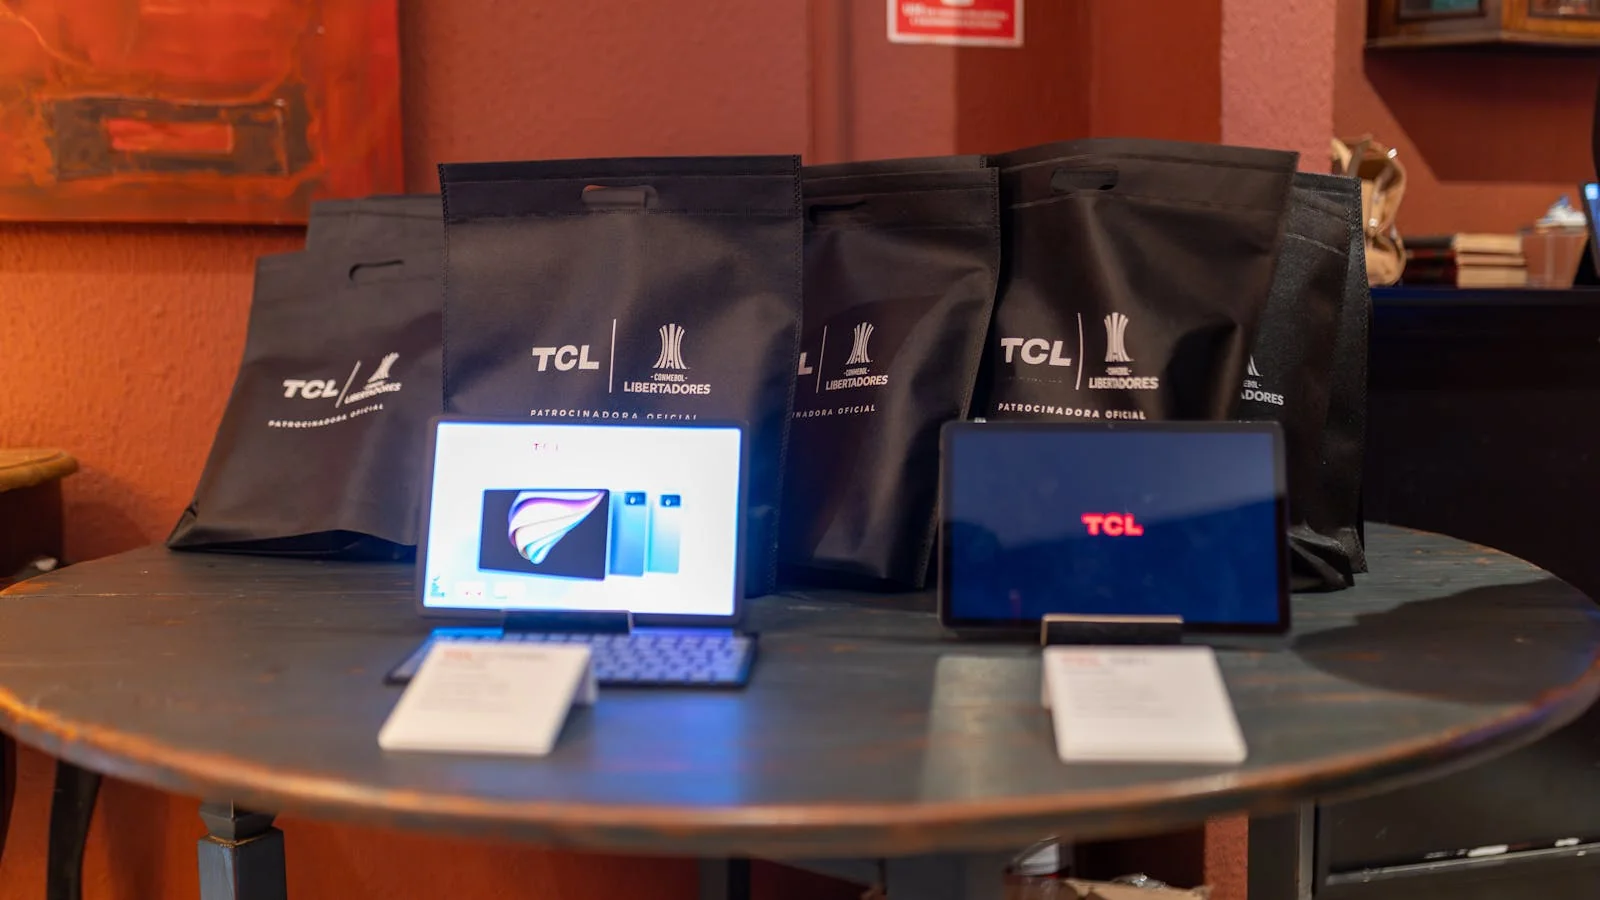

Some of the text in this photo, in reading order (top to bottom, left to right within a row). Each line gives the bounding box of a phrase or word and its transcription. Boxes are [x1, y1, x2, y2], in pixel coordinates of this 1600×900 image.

[532, 344, 600, 372] TCL
[1001, 337, 1072, 367] TCL
[282, 379, 339, 400] TCL
[623, 381, 711, 395] LIBERTADORES
[825, 375, 889, 391] LIBERTADORES
[1088, 376, 1160, 390] LIBERTADORES
[530, 409, 638, 419] PATROCINADORA
[791, 404, 876, 419] INADORA OFICIAL
[998, 403, 1147, 421] PATROCINADORA OFICIAL
[1081, 512, 1145, 537] TCL
